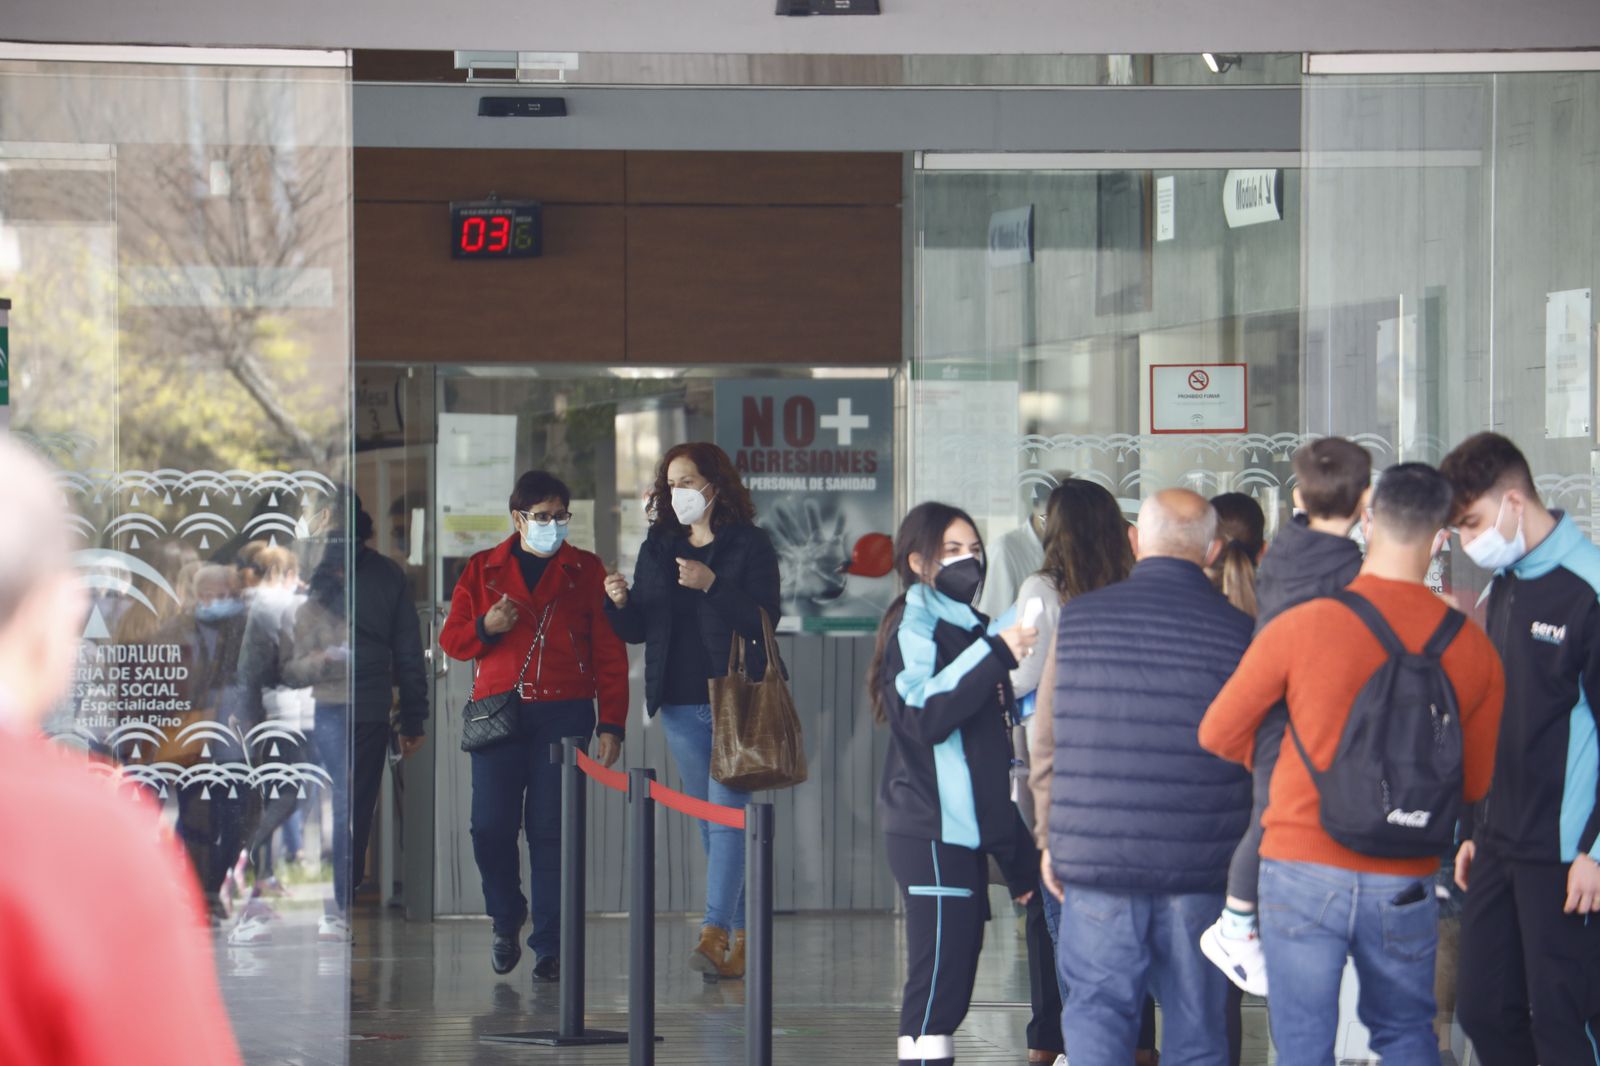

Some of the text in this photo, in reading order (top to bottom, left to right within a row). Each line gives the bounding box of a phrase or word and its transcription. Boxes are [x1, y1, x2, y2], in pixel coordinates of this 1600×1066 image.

[460, 216, 510, 253] 03
[736, 449, 877, 475] AGRESIONES
[750, 476, 808, 491] PERSONAL
[809, 476, 825, 491] DE
[825, 476, 877, 491] SANIDAD
[1531, 620, 1567, 641] servi
[96, 643, 182, 663] ANDALUCIA
[108, 666, 131, 681] DE
[134, 666, 189, 681] SALUD
[120, 682, 179, 697] SOCIAL
[81, 698, 191, 715] Especialidades
[120, 715, 144, 727] del
[147, 715, 182, 728] Pino
